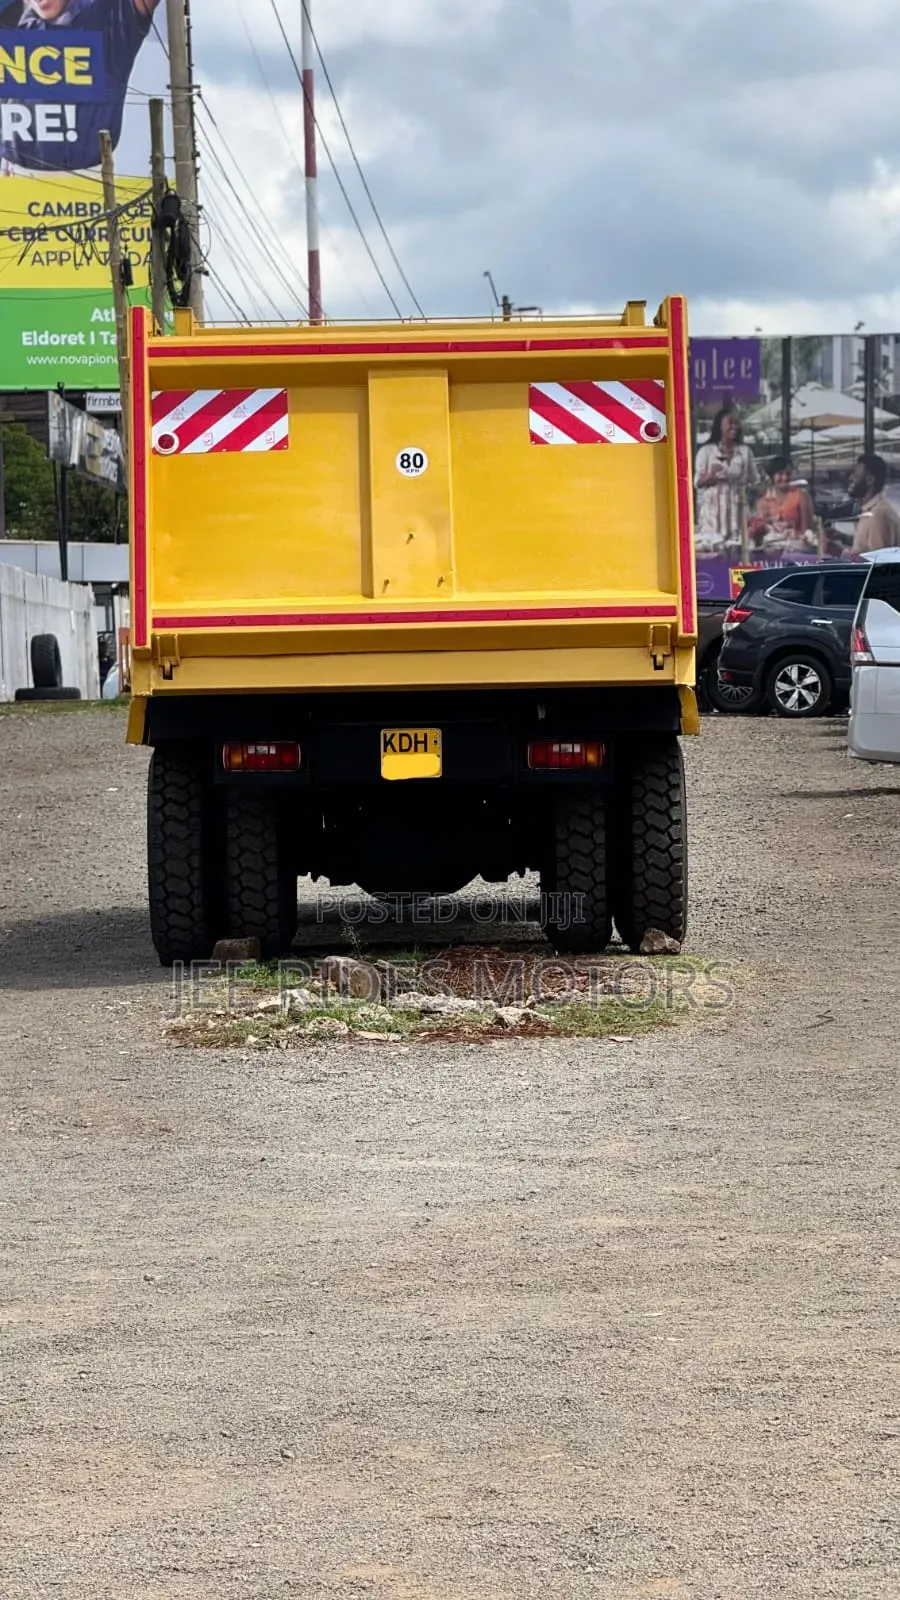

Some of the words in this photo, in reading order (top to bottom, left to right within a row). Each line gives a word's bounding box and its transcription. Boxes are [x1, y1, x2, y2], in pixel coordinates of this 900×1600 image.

[22, 330, 86, 346] Eldoret
[695, 347, 752, 389] glee
[400, 453, 424, 469] 80
[383, 733, 428, 753] KDH
